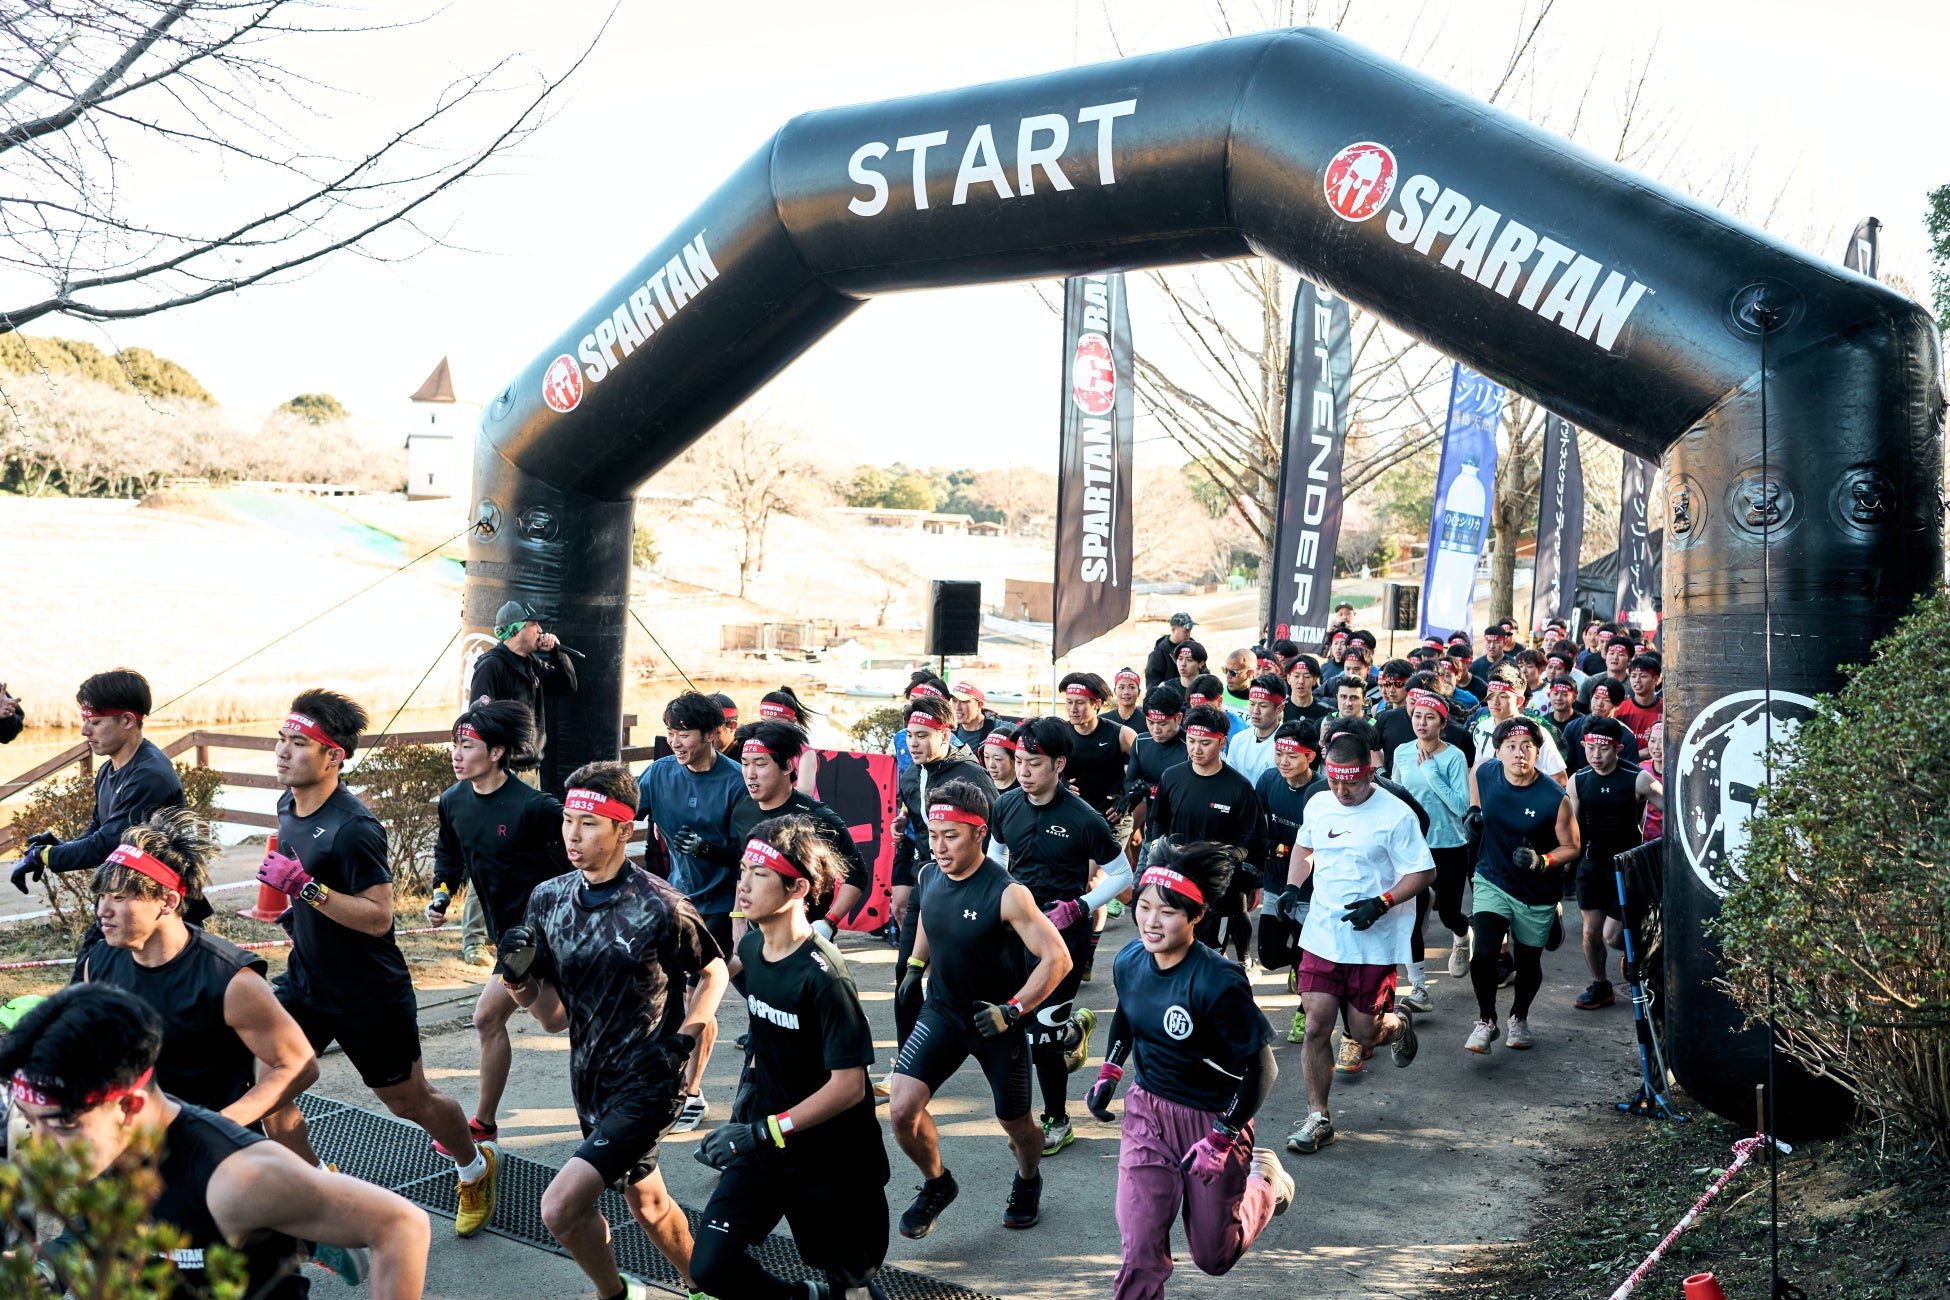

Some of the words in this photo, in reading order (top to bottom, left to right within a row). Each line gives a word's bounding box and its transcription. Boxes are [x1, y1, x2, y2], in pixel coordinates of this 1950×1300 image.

[847, 99, 1138, 217] START
[1385, 174, 1647, 352] SPARTAN
[577, 232, 720, 383] SPARTAN
[1083, 276, 1109, 334] RA
[1081, 418, 1112, 584] SPARTAN
[763, 710, 778, 718] 3509
[765, 704, 784, 713] SPARTAN
[571, 789, 608, 804] SPARTAN
[568, 800, 595, 811] 3835
[1214, 803, 1231, 811] SPARTAN
[1046, 829, 1070, 839] OAKLEY
[1146, 875, 1172, 888] 3338
[1149, 868, 1184, 882] SPARTAN
[1168, 1012, 1187, 1035] 防
